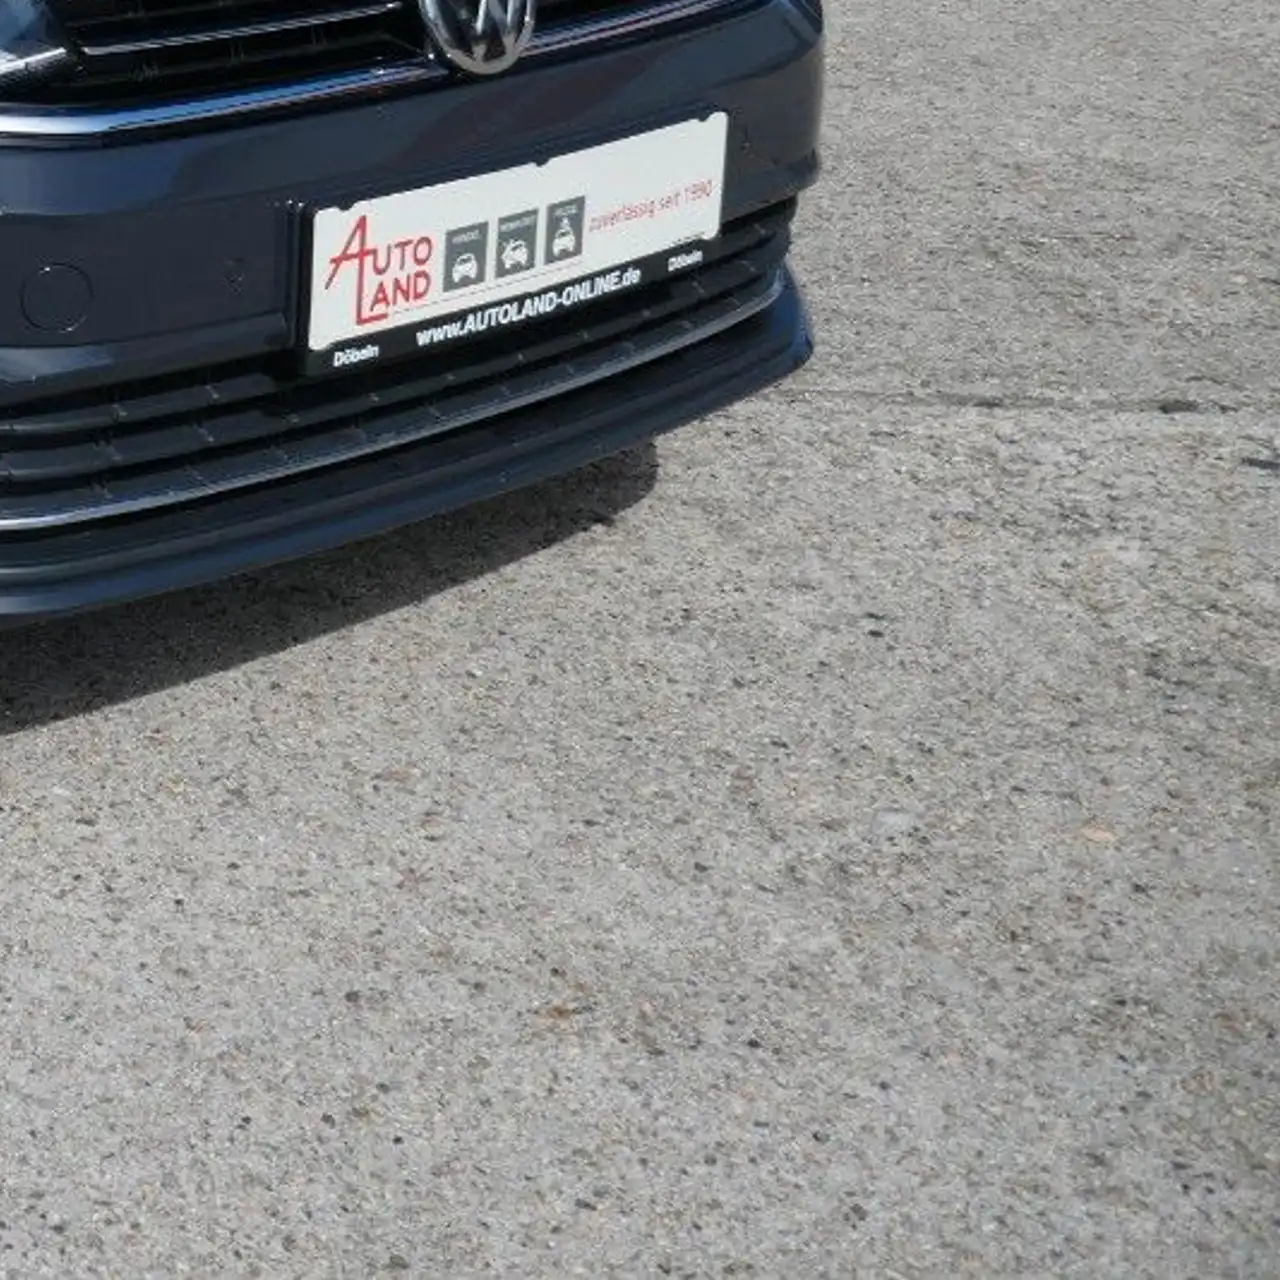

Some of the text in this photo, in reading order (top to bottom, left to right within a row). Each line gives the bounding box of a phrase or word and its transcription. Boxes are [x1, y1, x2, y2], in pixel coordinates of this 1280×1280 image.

[325, 215, 433, 290] AUTO
[356, 270, 432, 326] LAND
[333, 344, 380, 367] Döbeln
